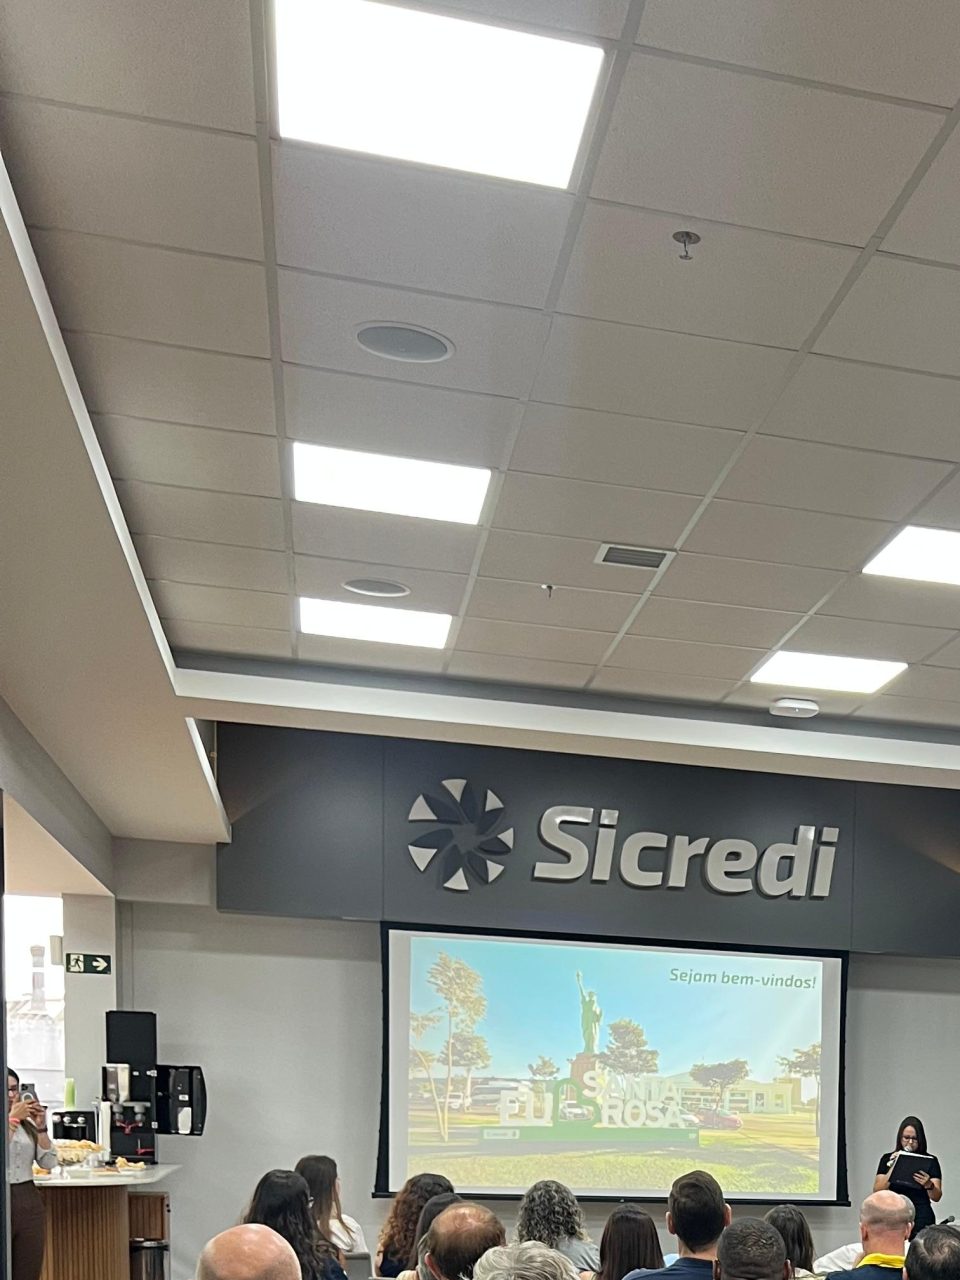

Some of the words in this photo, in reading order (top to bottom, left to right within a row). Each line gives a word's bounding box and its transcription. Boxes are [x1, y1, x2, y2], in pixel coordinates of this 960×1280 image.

[533, 805, 840, 899] Sicredi
[669, 967, 718, 985] Sejam
[721, 970, 817, 989] bem-vindos!
[582, 1069, 680, 1103] SANTA
[600, 1099, 687, 1129] ROSA
